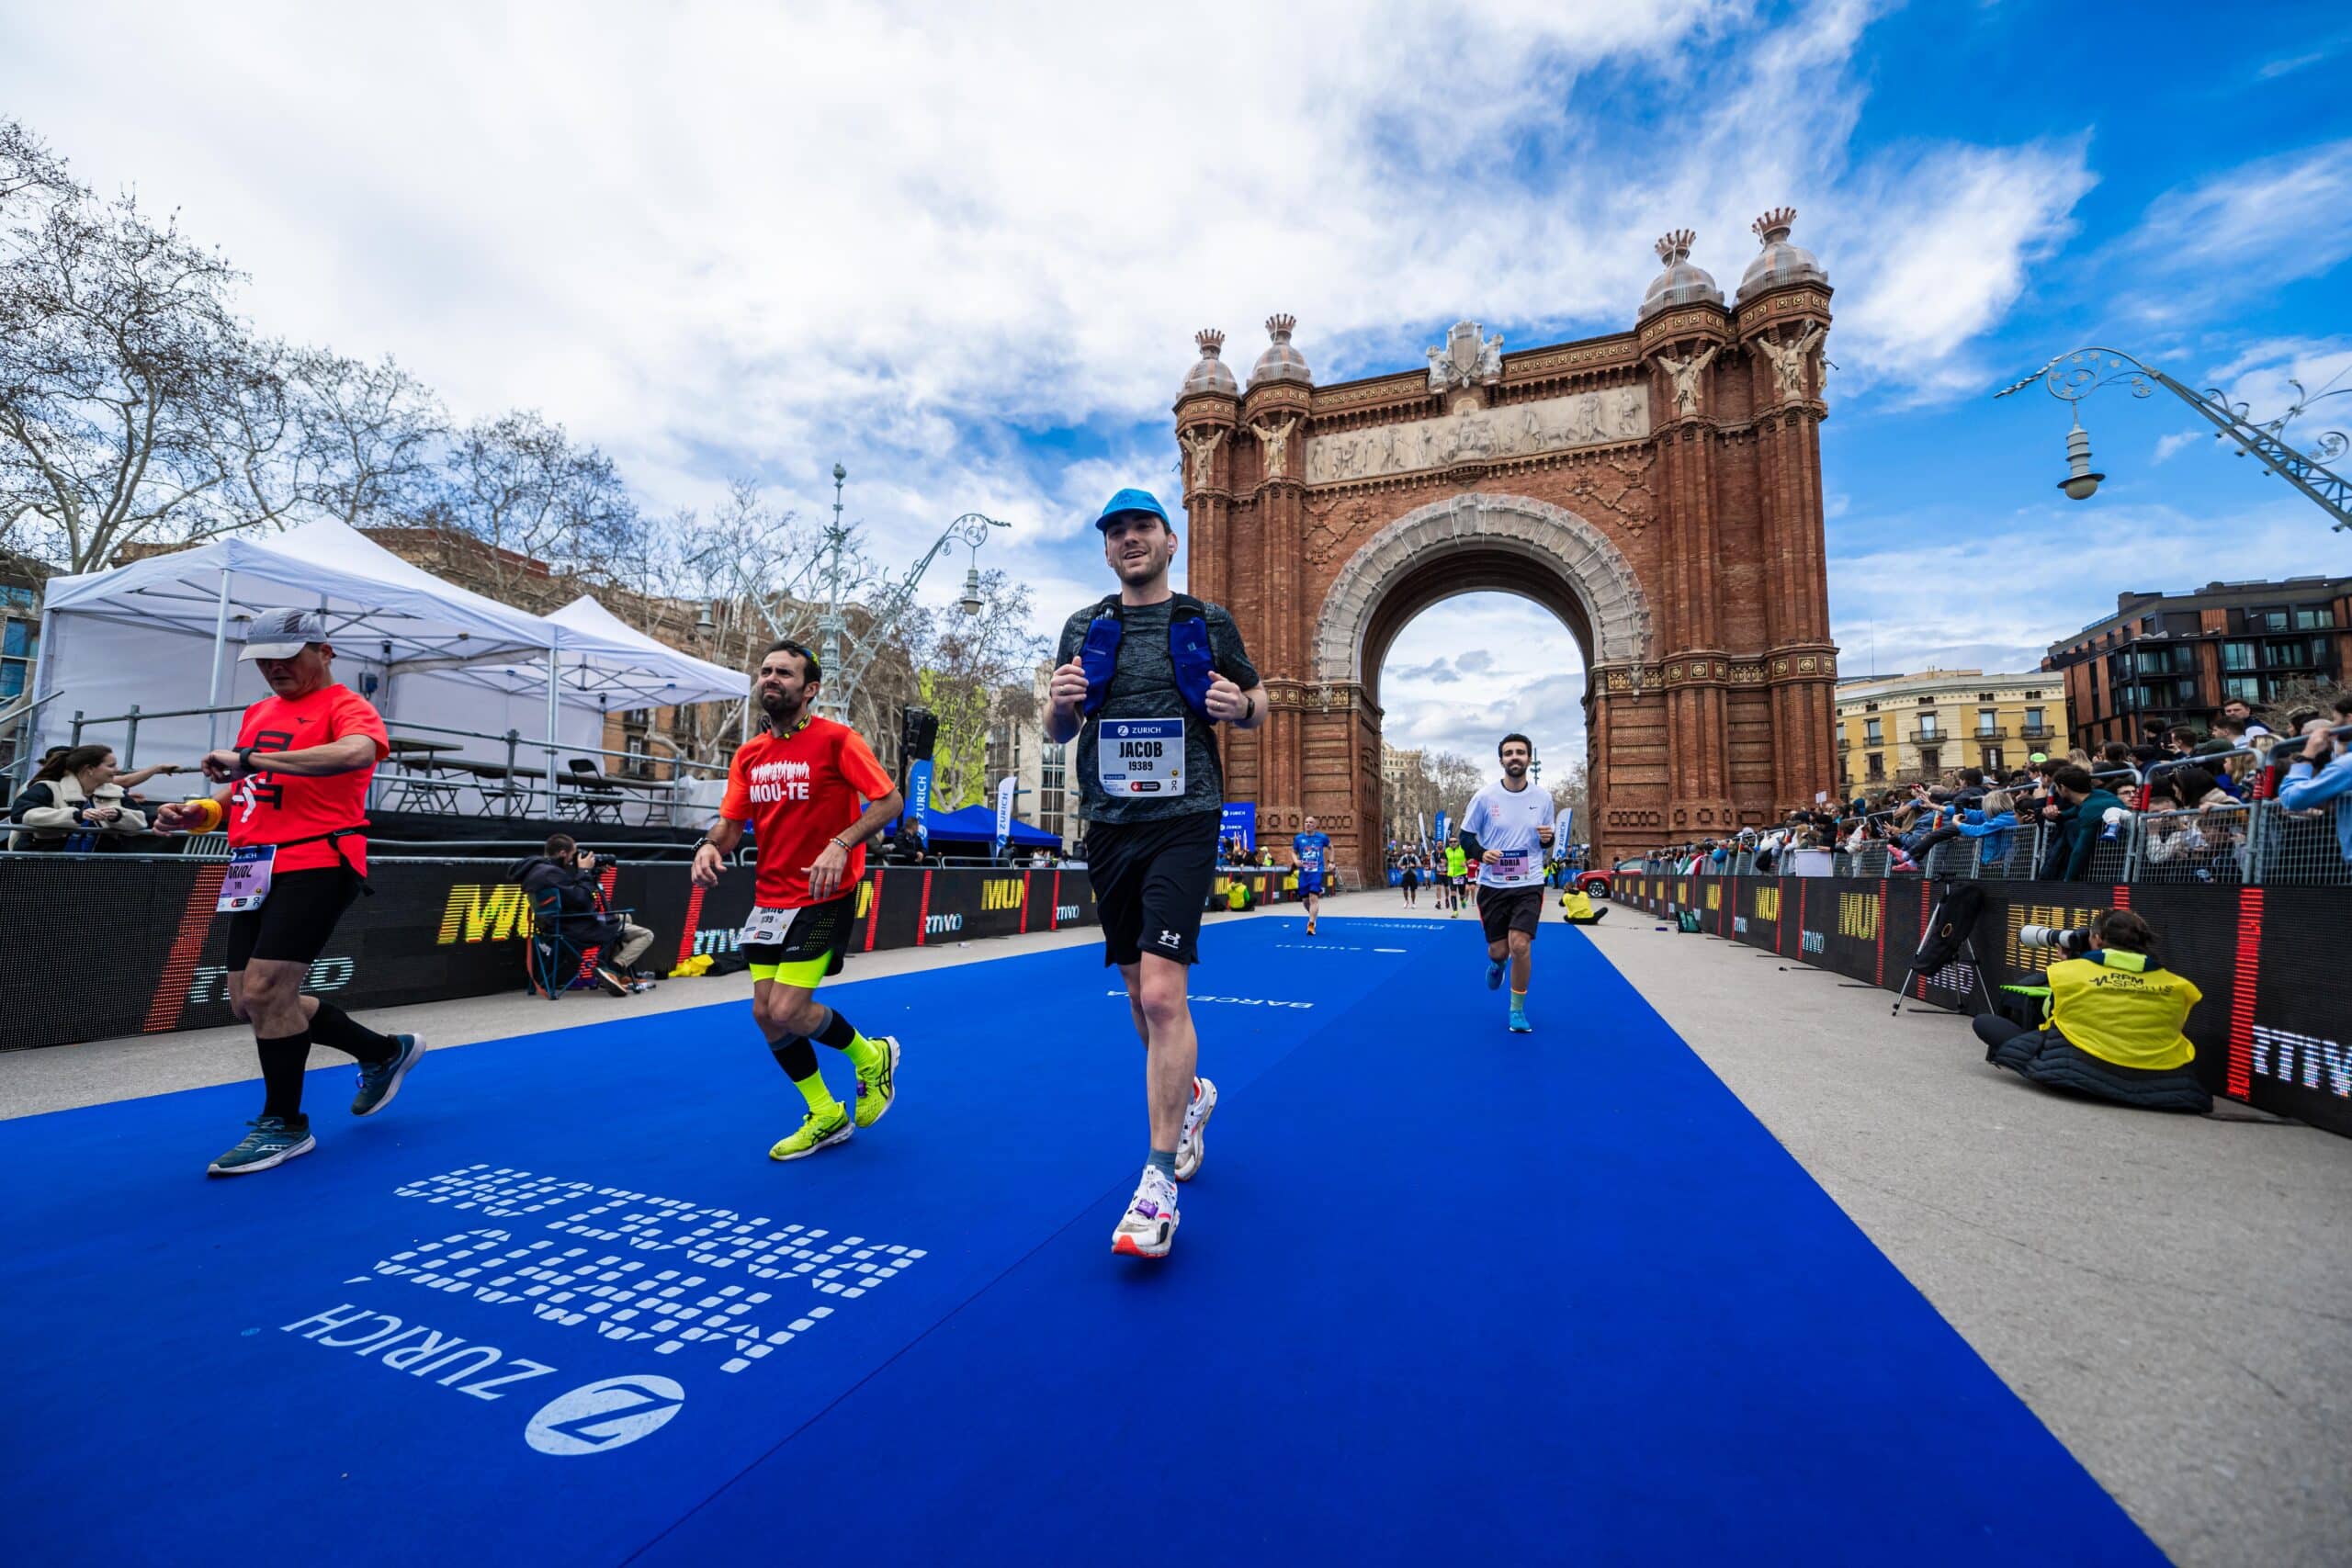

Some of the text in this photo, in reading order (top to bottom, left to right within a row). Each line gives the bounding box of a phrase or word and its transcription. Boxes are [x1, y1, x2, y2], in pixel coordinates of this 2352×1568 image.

[1119, 741, 1163, 758] JACOB
[1128, 761, 1153, 771] 19389
[750, 781, 809, 803] MOU-TE
[916, 775, 927, 818] ZURICH
[1000, 793, 1009, 829] ZURICH
[2111, 973, 2144, 985] RPM
[281, 1303, 559, 1401] ZURICH
